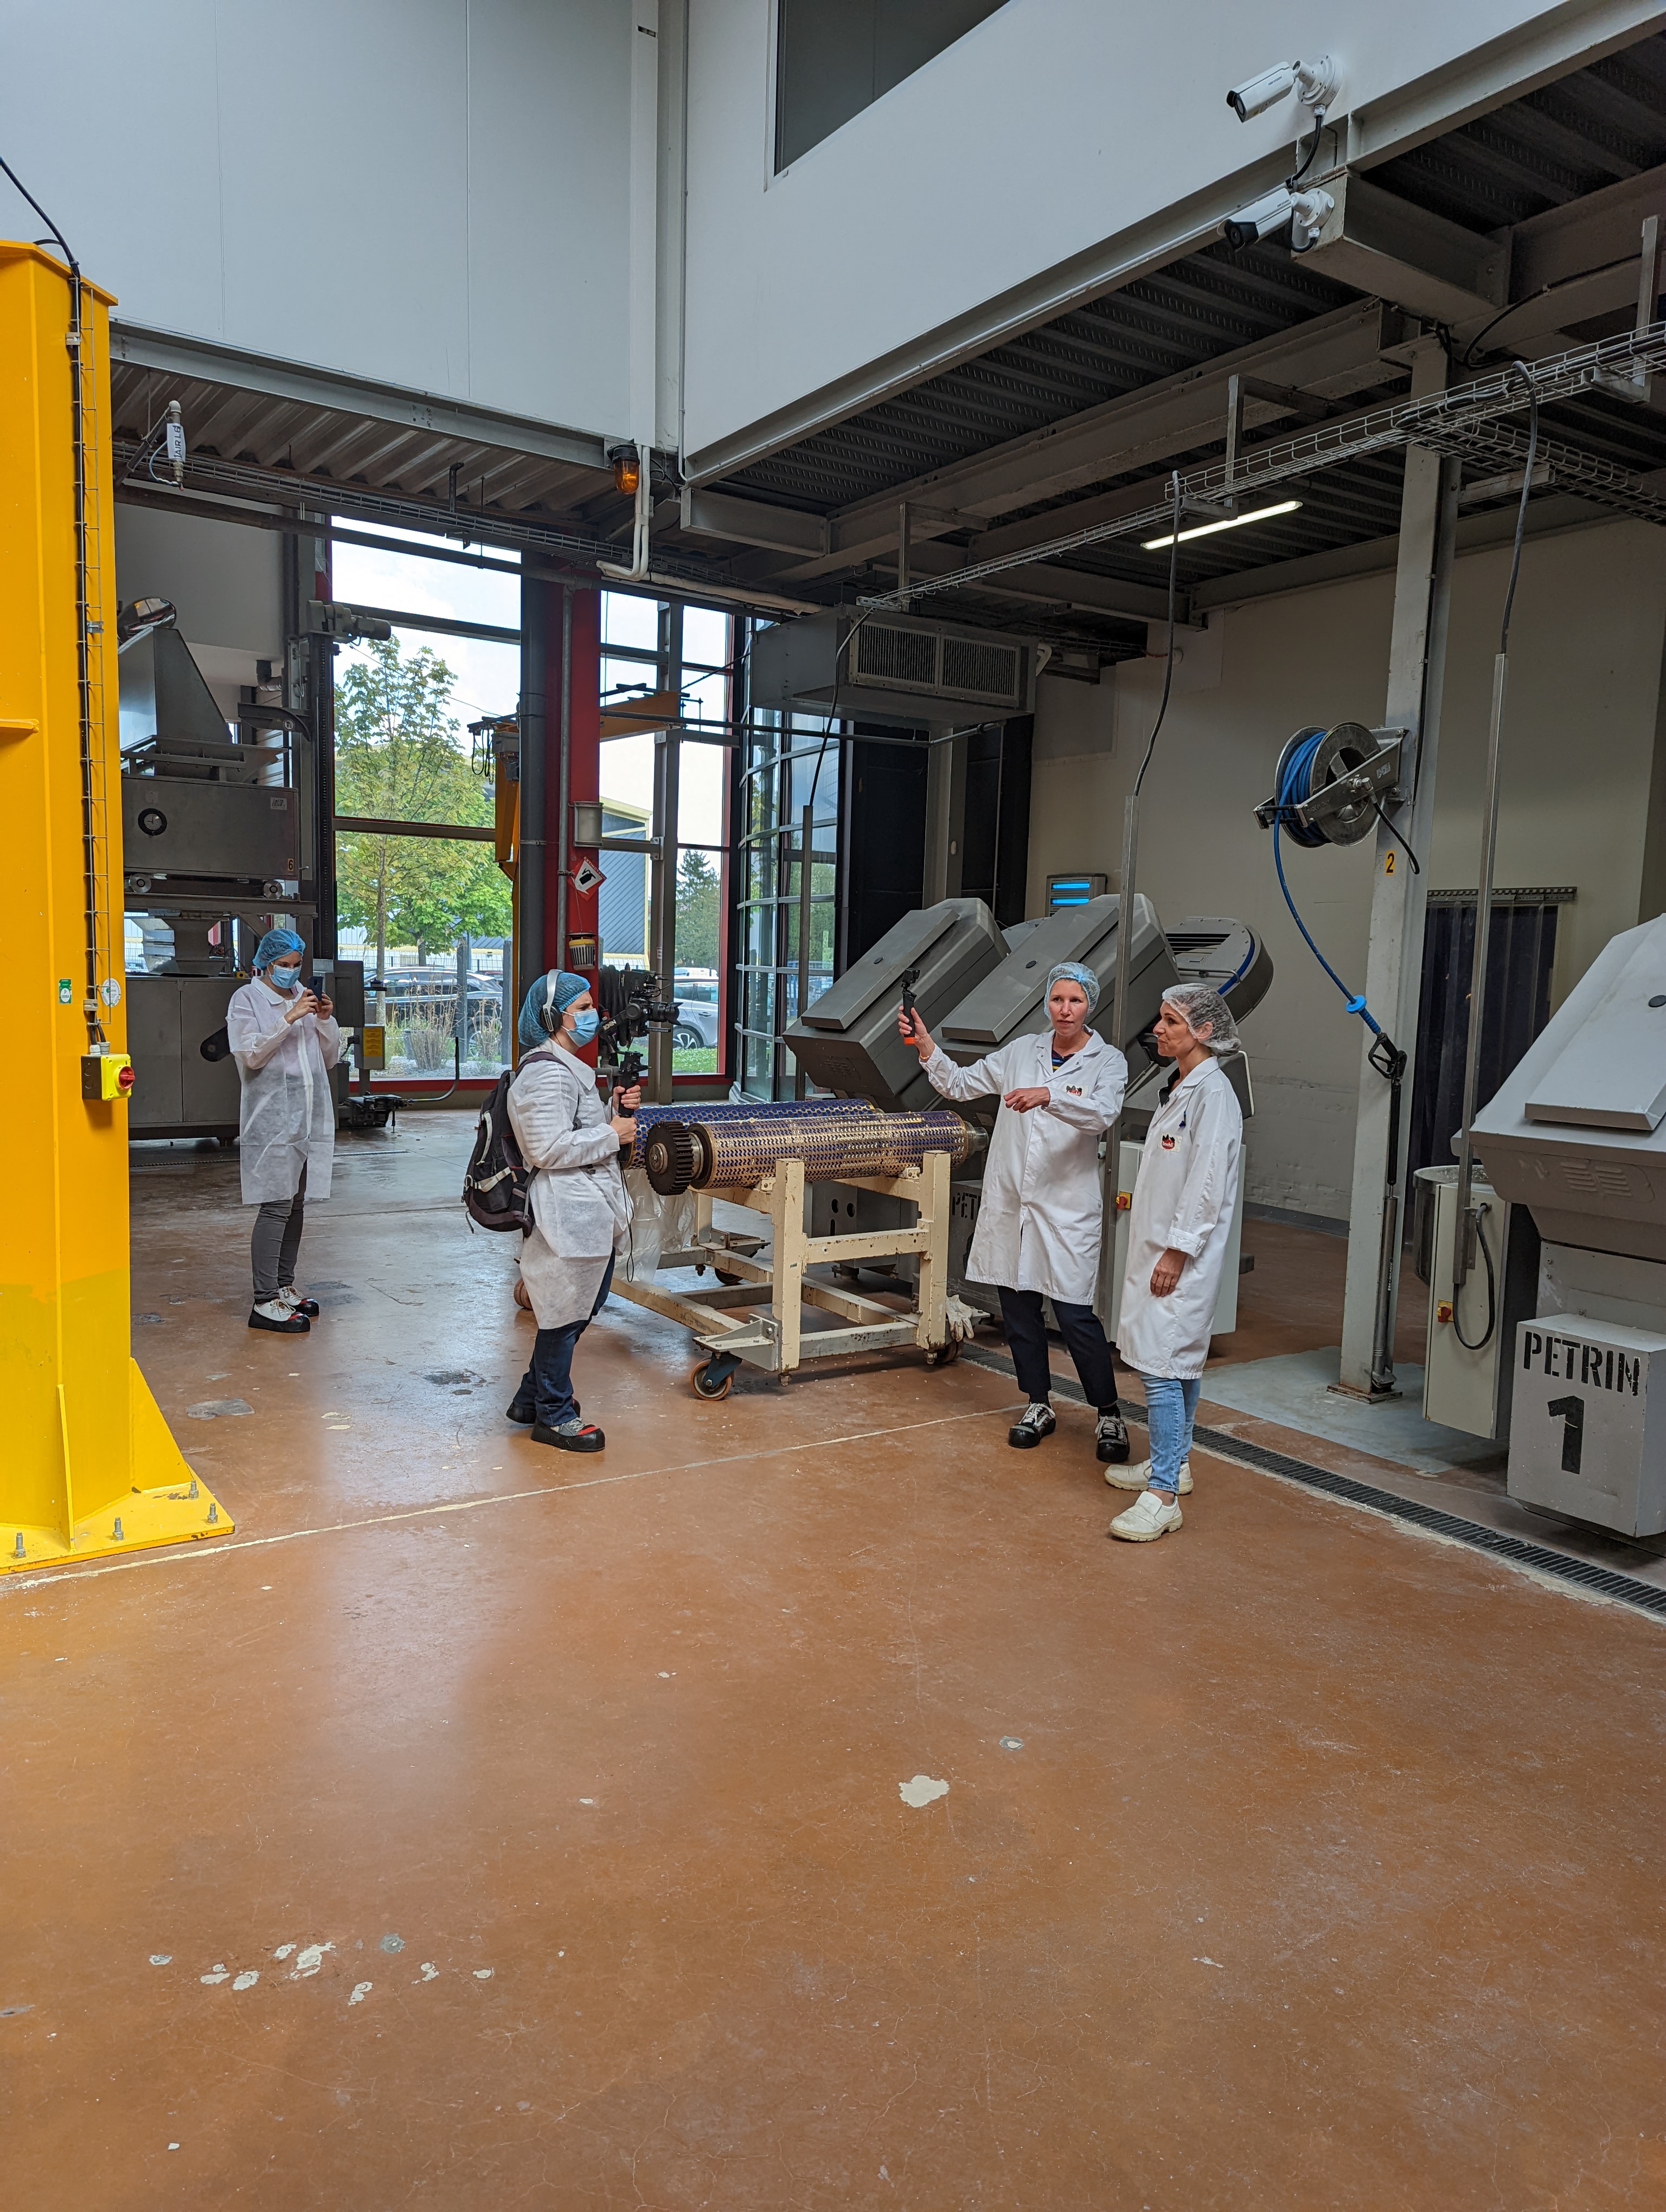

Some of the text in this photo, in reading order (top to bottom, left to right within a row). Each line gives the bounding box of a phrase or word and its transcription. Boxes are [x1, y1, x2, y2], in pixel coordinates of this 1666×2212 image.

[289, 859, 293, 870] 6
[1386, 852, 1394, 873] 2
[603, 1019, 617, 1031] RONIN
[951, 1192, 981, 1220] PET
[1523, 1331, 1640, 1396] PETRIN
[1547, 1395, 1585, 1475] 1
